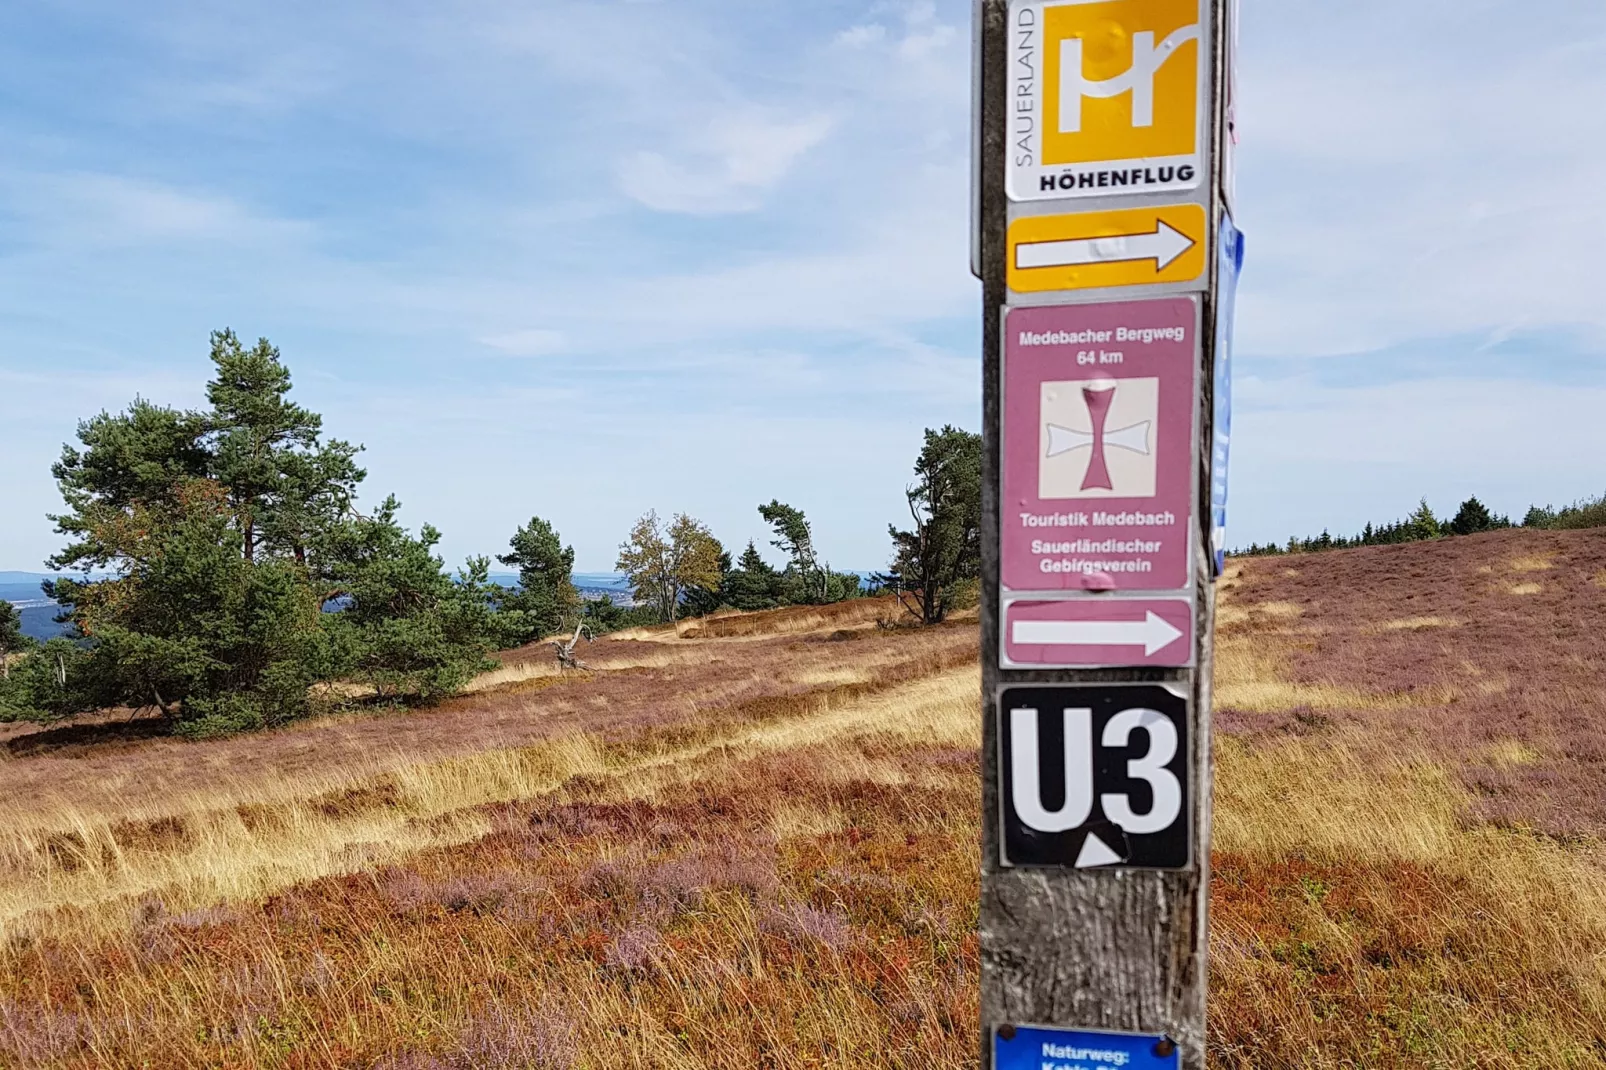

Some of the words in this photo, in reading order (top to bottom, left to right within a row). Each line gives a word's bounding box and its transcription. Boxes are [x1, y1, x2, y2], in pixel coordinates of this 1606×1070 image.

[1016, 8, 1035, 167] SAUERLAND
[1040, 164, 1195, 191] HÖHENFLUG
[1019, 329, 1112, 346] Medebacher
[1116, 326, 1185, 343] Bergweg
[1076, 351, 1096, 365] 64
[1100, 350, 1124, 364] km
[1020, 512, 1089, 527] Touristik
[1093, 511, 1175, 526] Medebach
[1031, 539, 1162, 554] Sauerländischer
[1040, 558, 1152, 574] Gebirgsverein
[1010, 707, 1182, 834] U3
[1042, 1042, 1130, 1066] Naturweg:
